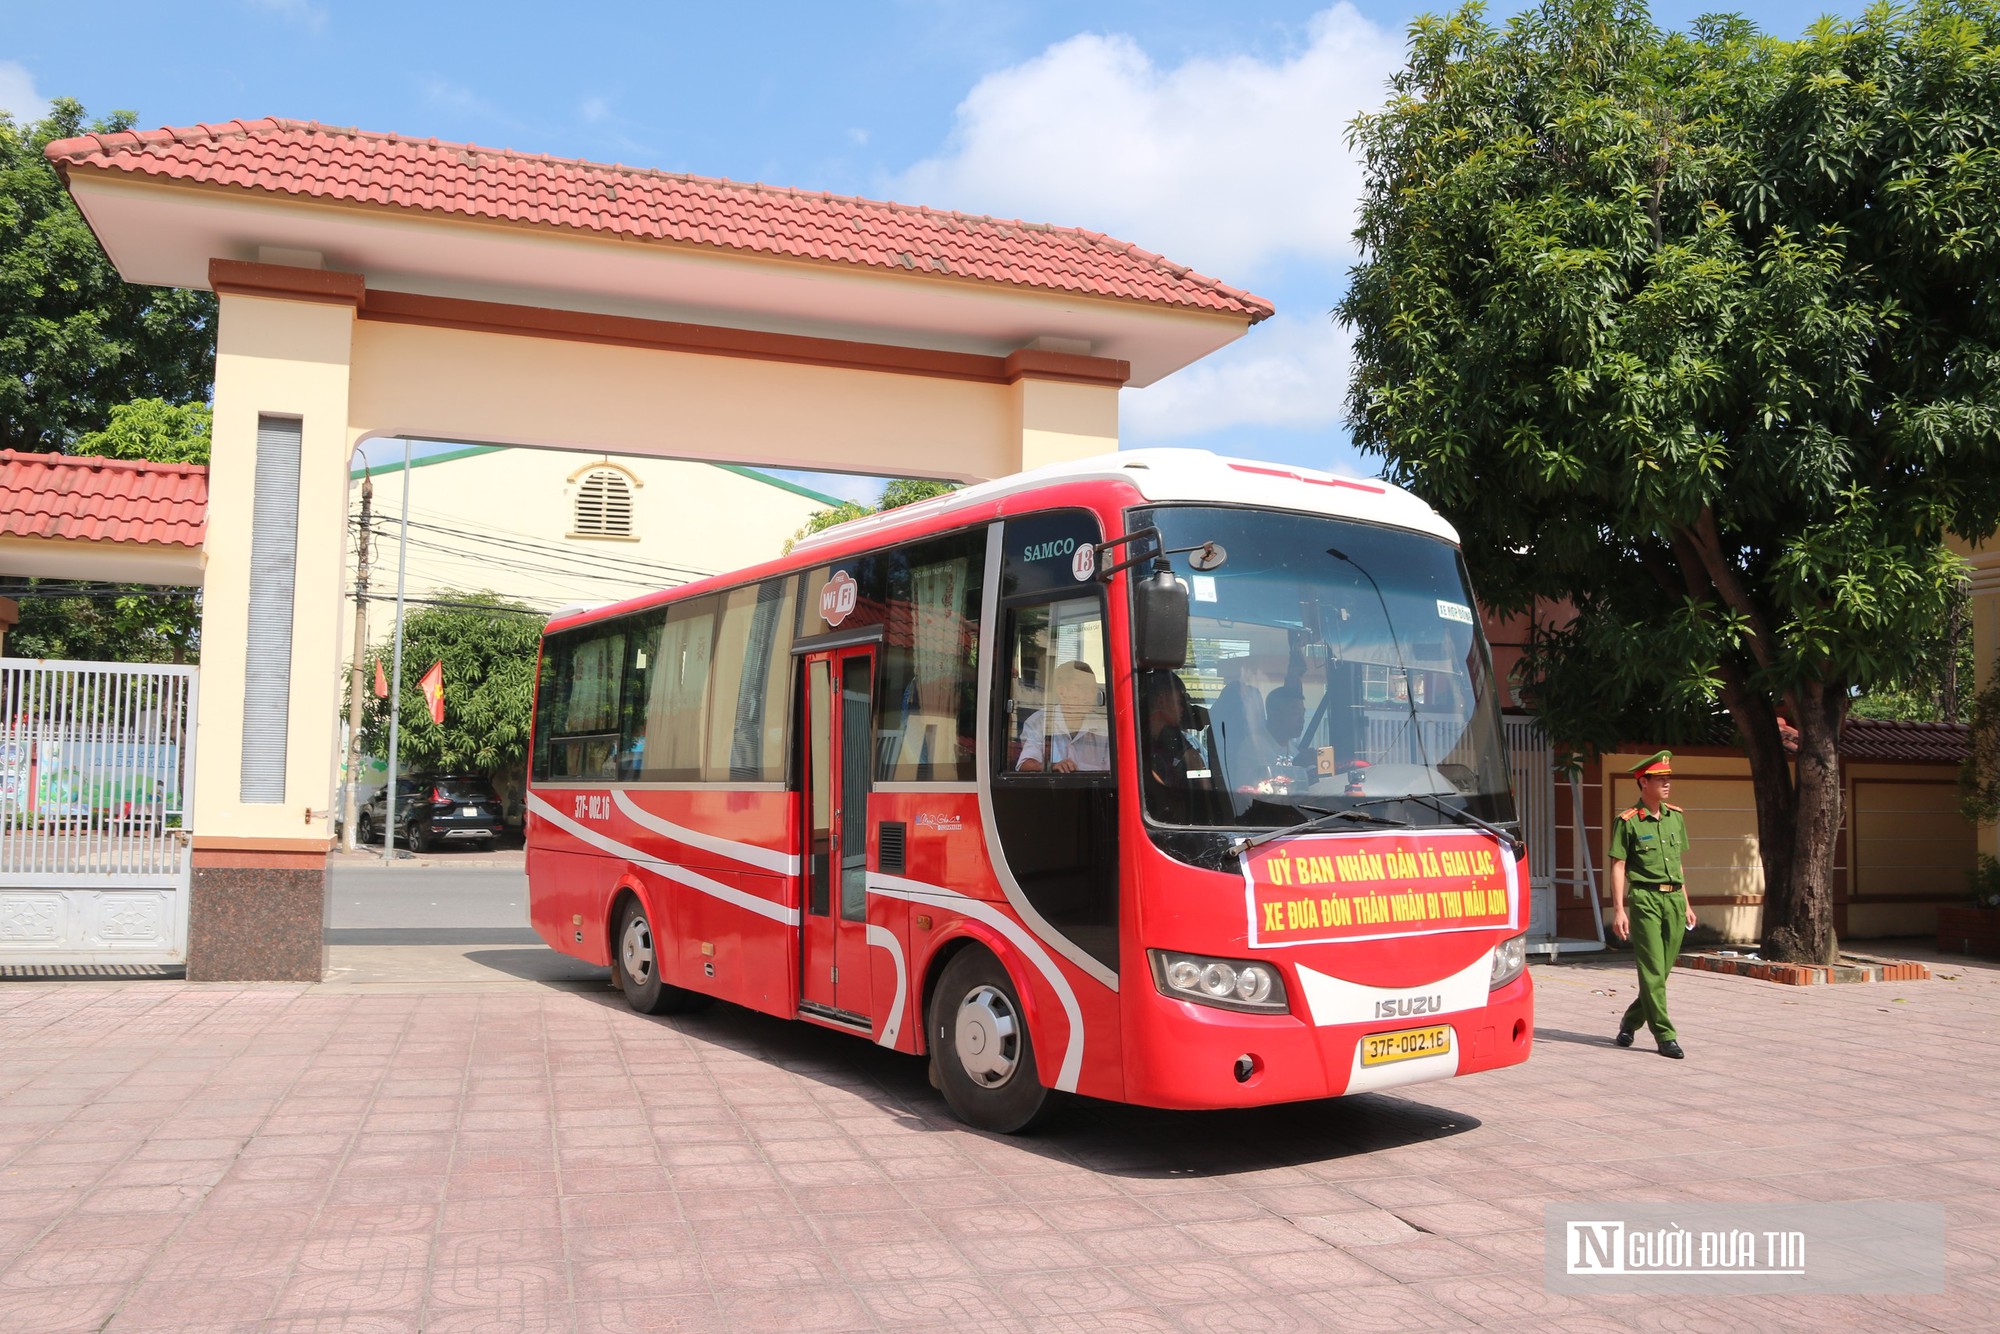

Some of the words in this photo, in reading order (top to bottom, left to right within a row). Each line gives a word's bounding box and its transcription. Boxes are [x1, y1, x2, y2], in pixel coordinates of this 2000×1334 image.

[1023, 537, 1075, 563] SAMCO
[1074, 549, 1093, 574] 13
[1439, 604, 1448, 616] XE
[1295, 856, 1336, 885] BAN
[1335, 849, 1386, 882] NHÂN
[1385, 847, 1420, 879] DÂN
[1418, 847, 1442, 878] XÃ
[1440, 850, 1471, 877] GIAI
[1468, 850, 1496, 881] LẠC
[1263, 902, 1286, 931] XE
[1287, 897, 1320, 930] ĐƯA
[1320, 892, 1352, 927] ĐÓN
[1352, 890, 1390, 925] THÂN
[1390, 888, 1427, 922] NHÂN
[1426, 892, 1441, 919] ĐI
[1440, 891, 1463, 918] THU
[1462, 880, 1487, 917] MẪU
[1487, 889, 1507, 915] ADN
[1374, 994, 1442, 1019] ISUZU
[1370, 1031, 1444, 1058] 37F-002.16
